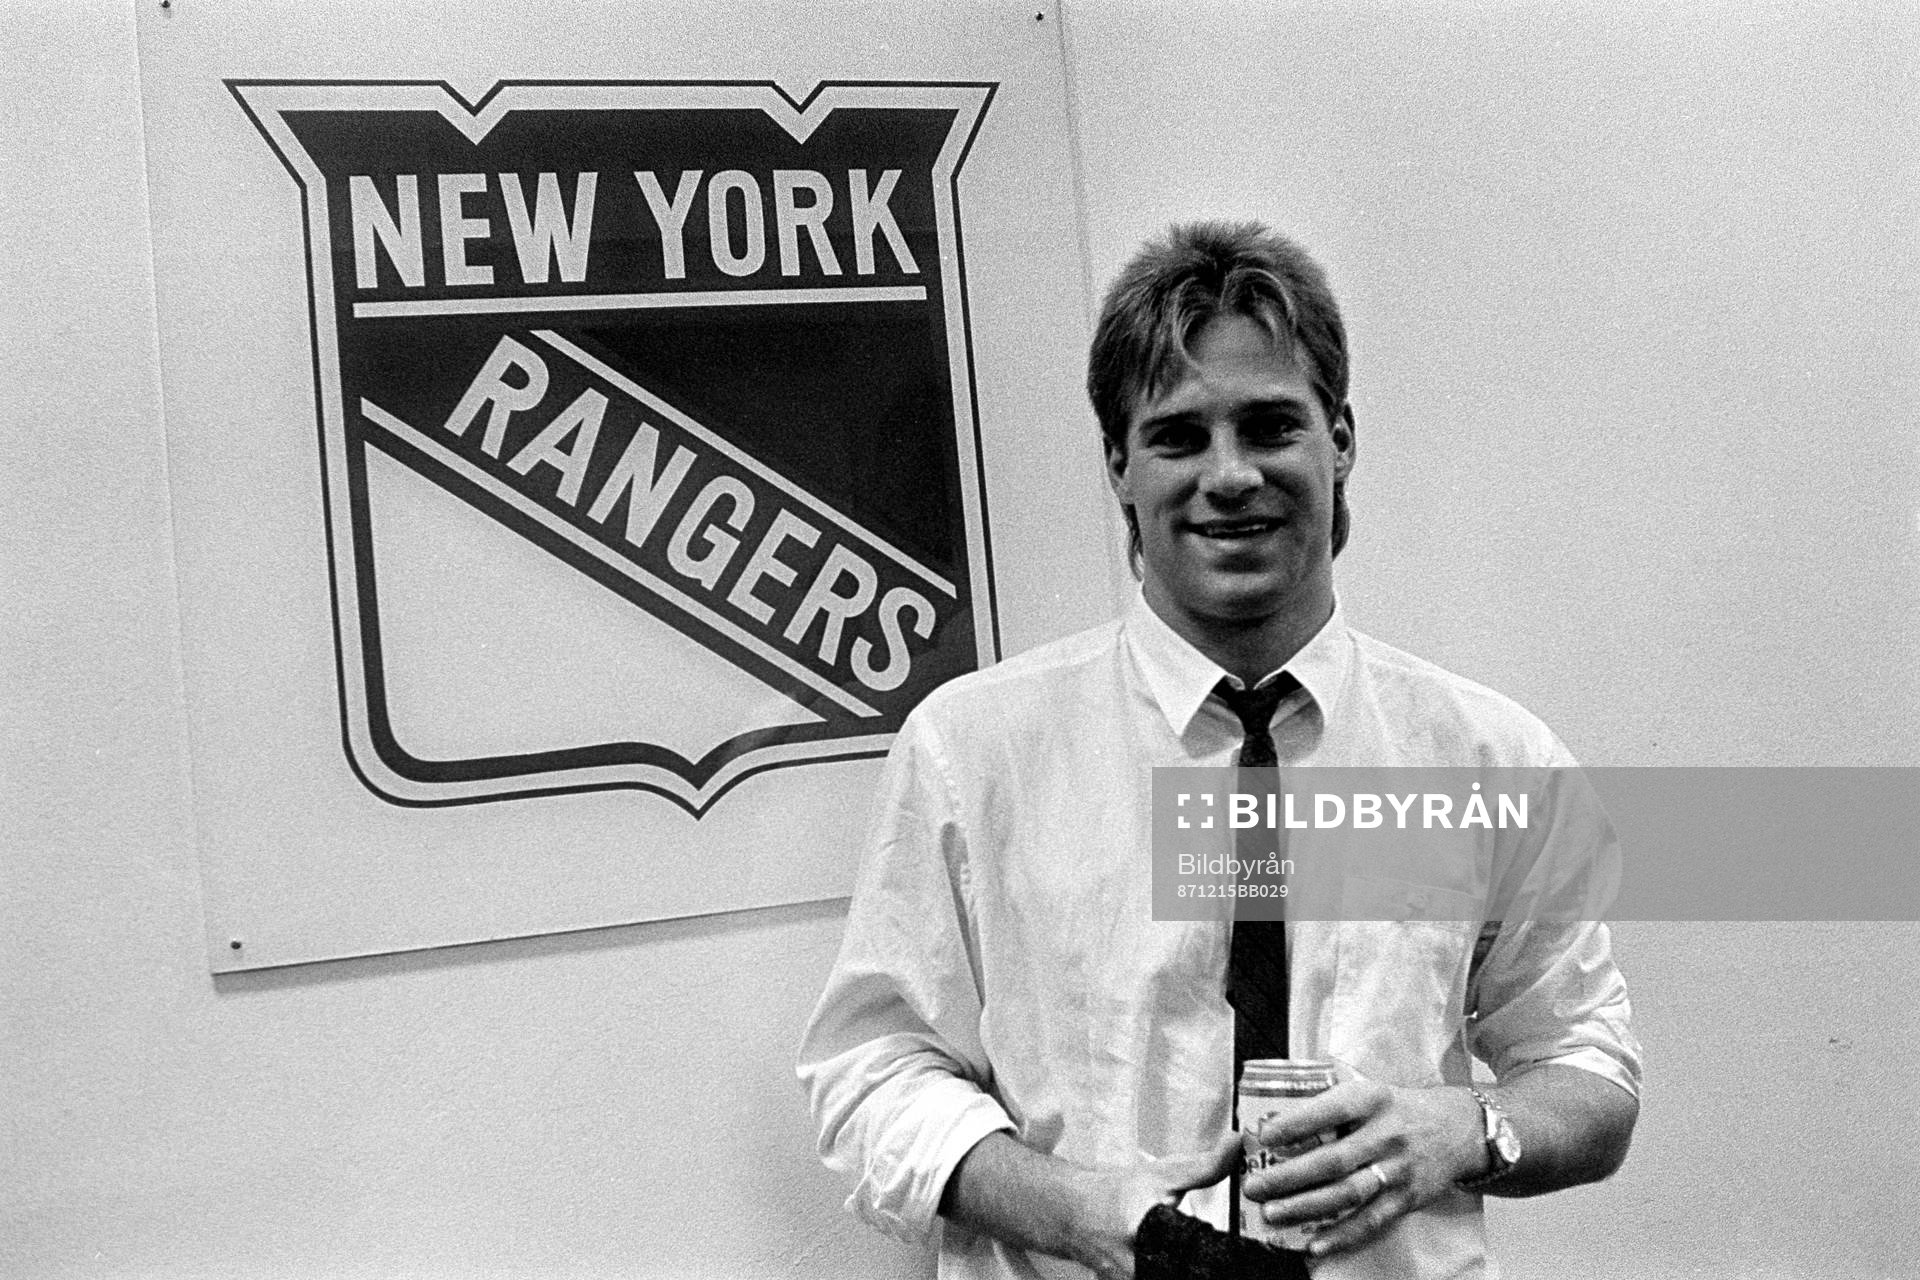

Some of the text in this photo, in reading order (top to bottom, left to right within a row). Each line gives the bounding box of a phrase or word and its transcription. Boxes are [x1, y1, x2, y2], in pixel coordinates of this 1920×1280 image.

[349, 168, 921, 289] NEW YORK
[443, 334, 937, 692] RANGERS
